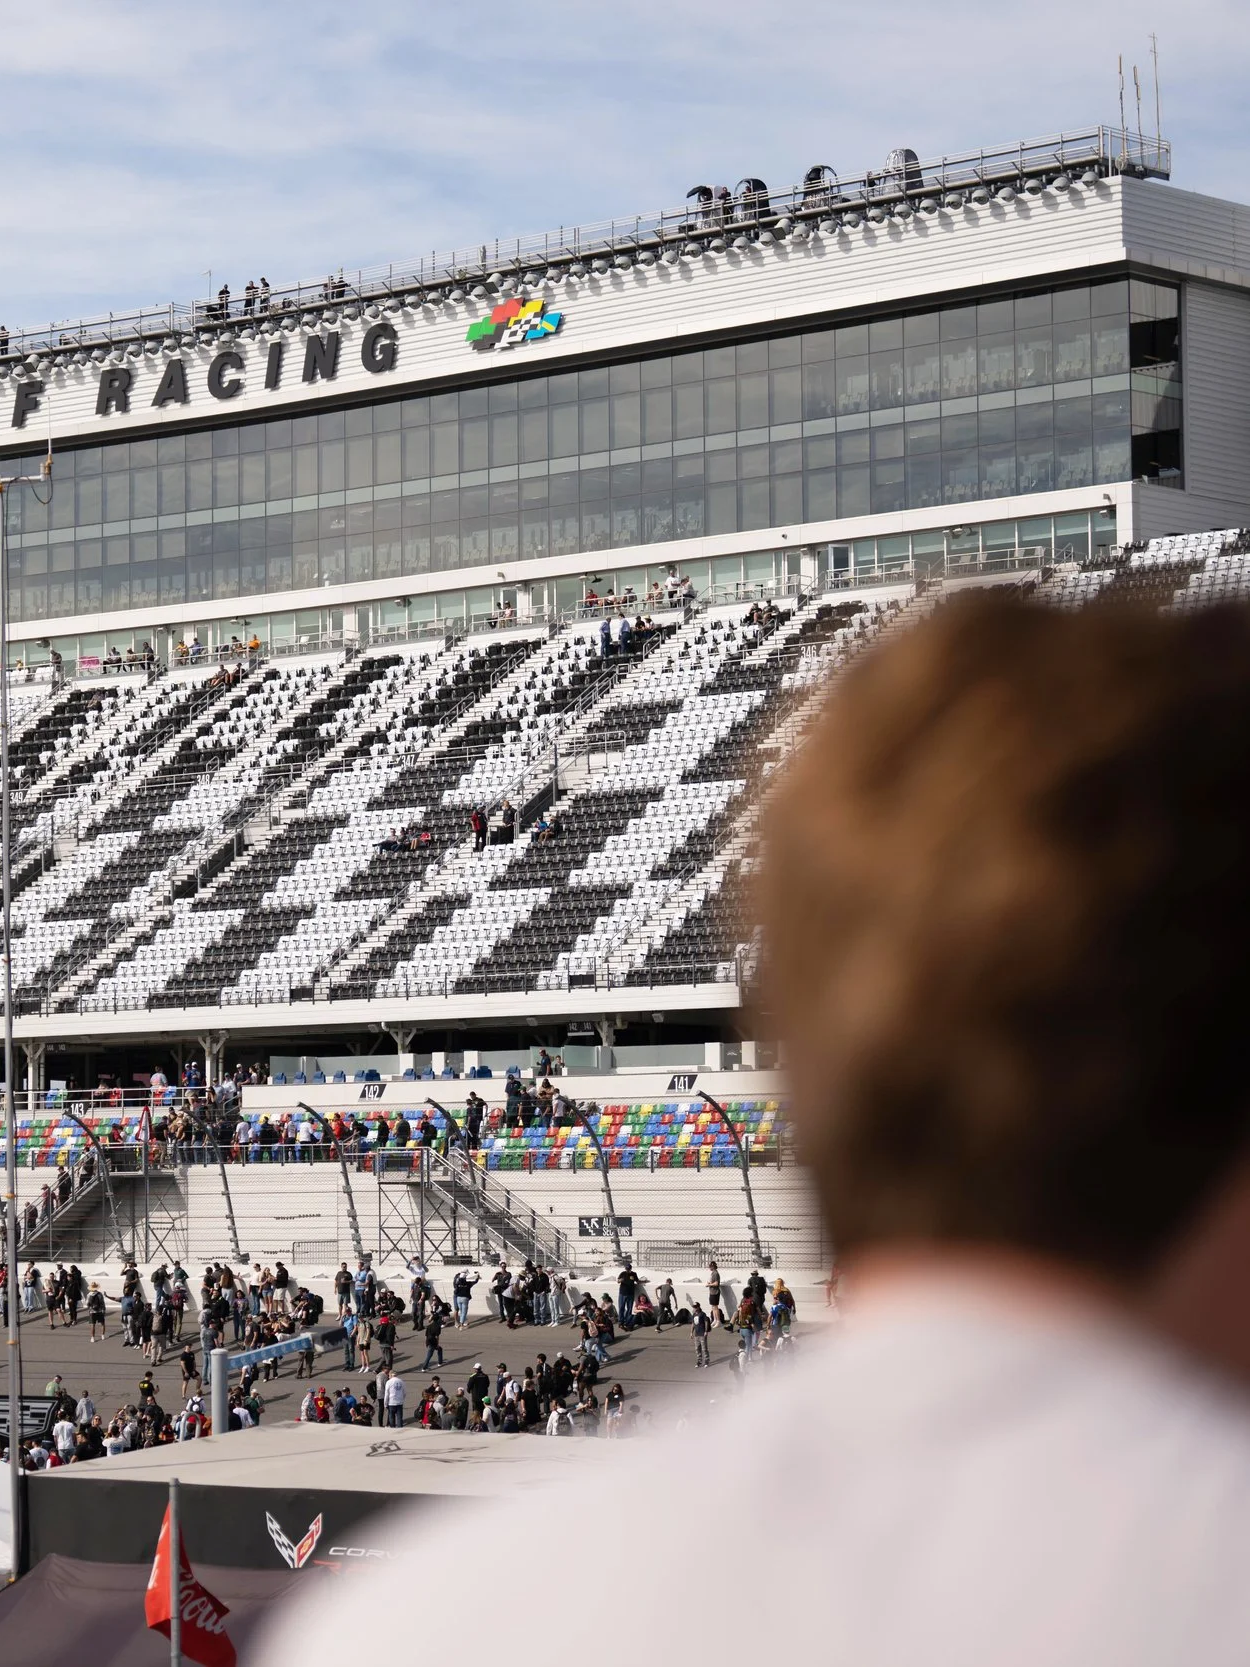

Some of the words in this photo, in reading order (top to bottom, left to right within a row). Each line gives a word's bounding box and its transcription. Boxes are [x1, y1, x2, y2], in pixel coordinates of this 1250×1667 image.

[95, 322, 397, 415] RACING
[800, 645, 817, 659] 346
[401, 754, 415, 768] 347
[9, 791, 25, 806] 349
[673, 1075, 689, 1093] 141
[364, 1084, 381, 1101] 142
[70, 1102, 85, 1118] 143
[602, 1226, 630, 1236] SECONS
